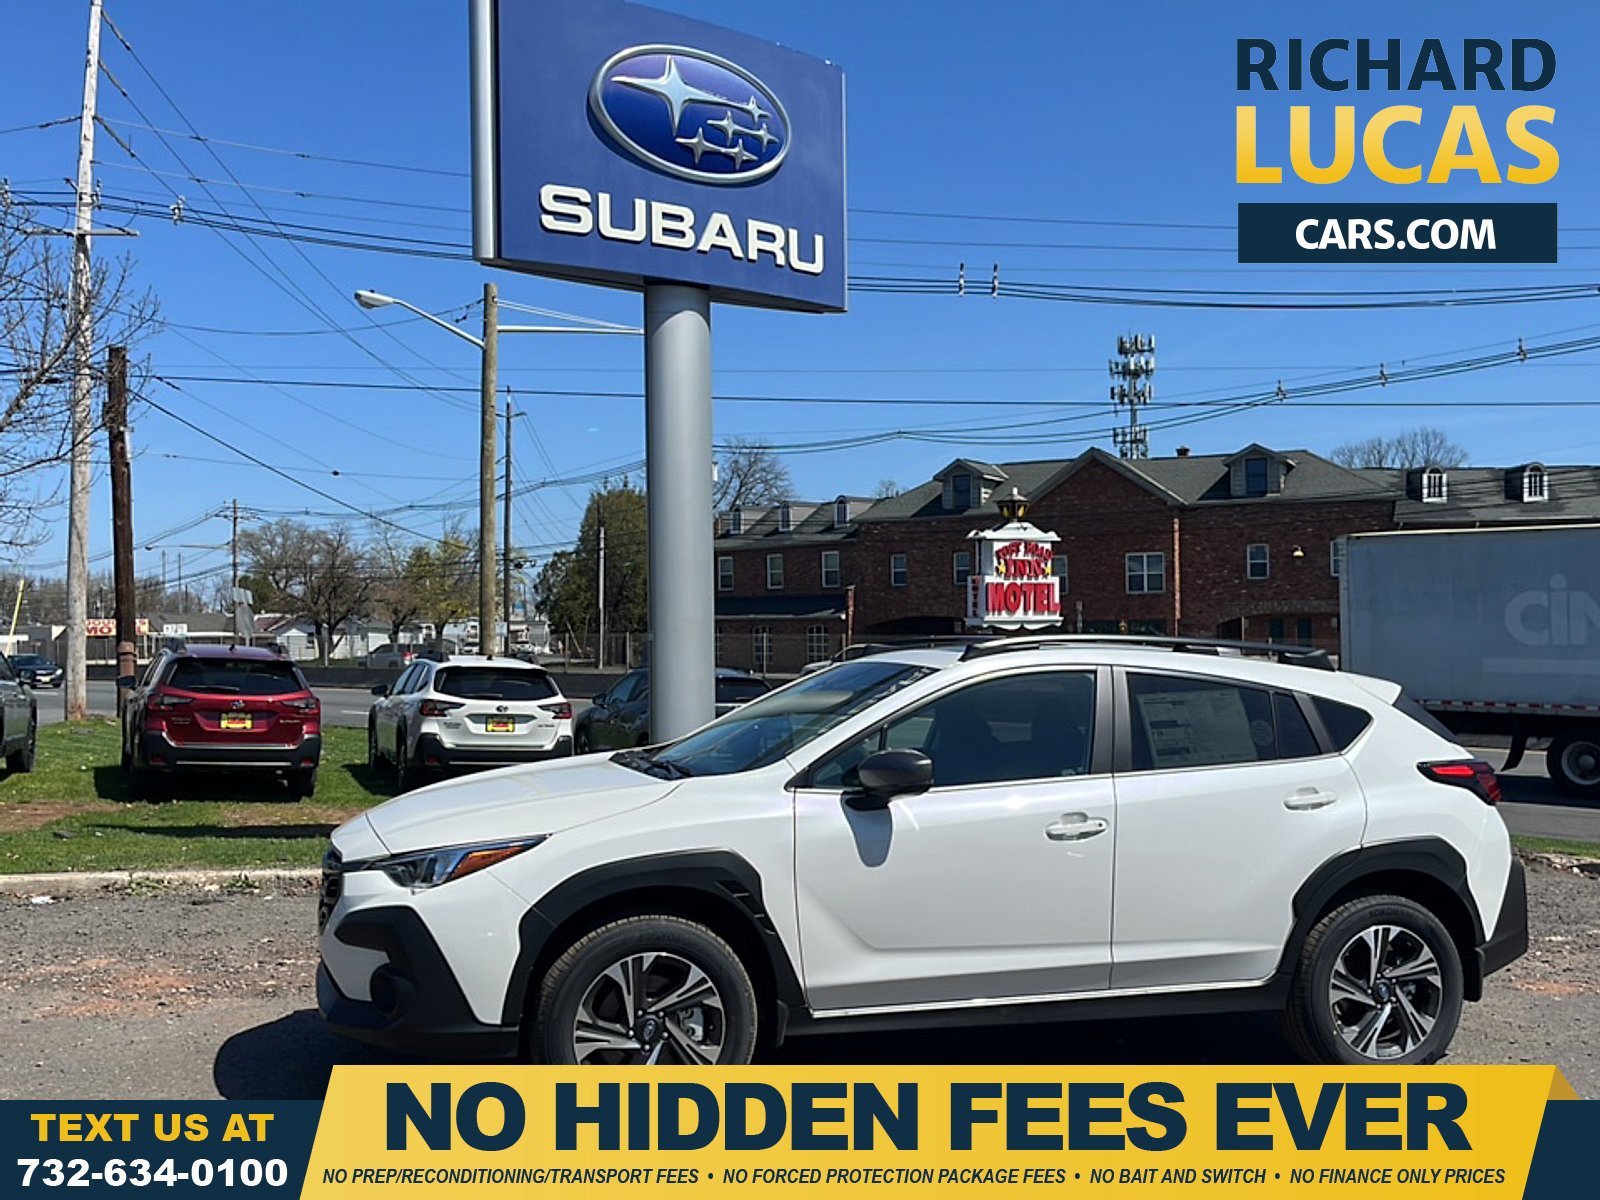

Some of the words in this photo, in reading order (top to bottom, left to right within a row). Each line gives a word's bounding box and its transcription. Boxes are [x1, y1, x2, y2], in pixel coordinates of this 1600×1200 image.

[539, 184, 825, 274] SUBARU
[1005, 559, 1043, 578] INN
[987, 582, 1061, 614] MOTEL
